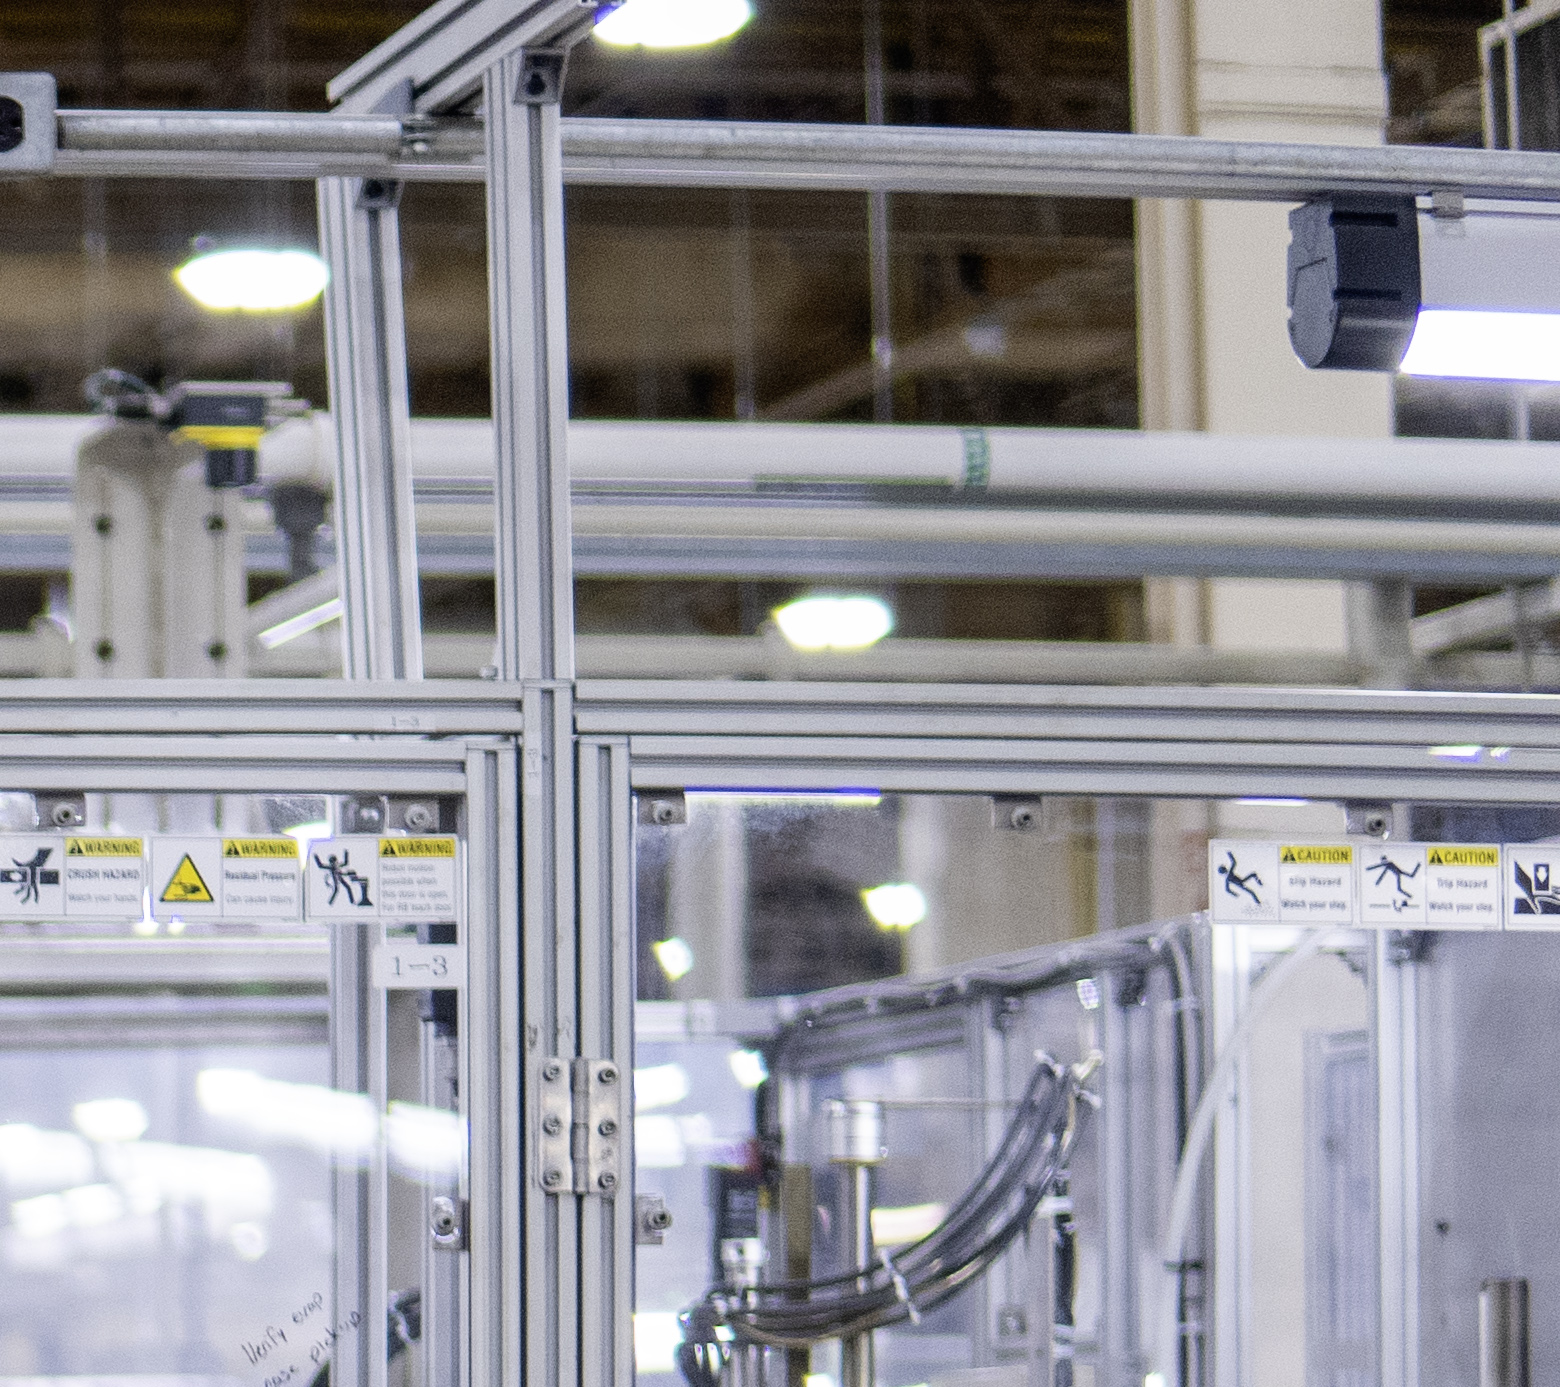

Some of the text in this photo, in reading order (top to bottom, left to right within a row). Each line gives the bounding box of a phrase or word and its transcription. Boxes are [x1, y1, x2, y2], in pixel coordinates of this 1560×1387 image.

[85, 840, 141, 854] WARNING
[242, 841, 296, 856] WARNING
[398, 841, 452, 856] WARNING
[1297, 849, 1349, 863] CAUTION
[1443, 850, 1496, 864] CAUTION
[394, 955, 448, 976] 1-3
